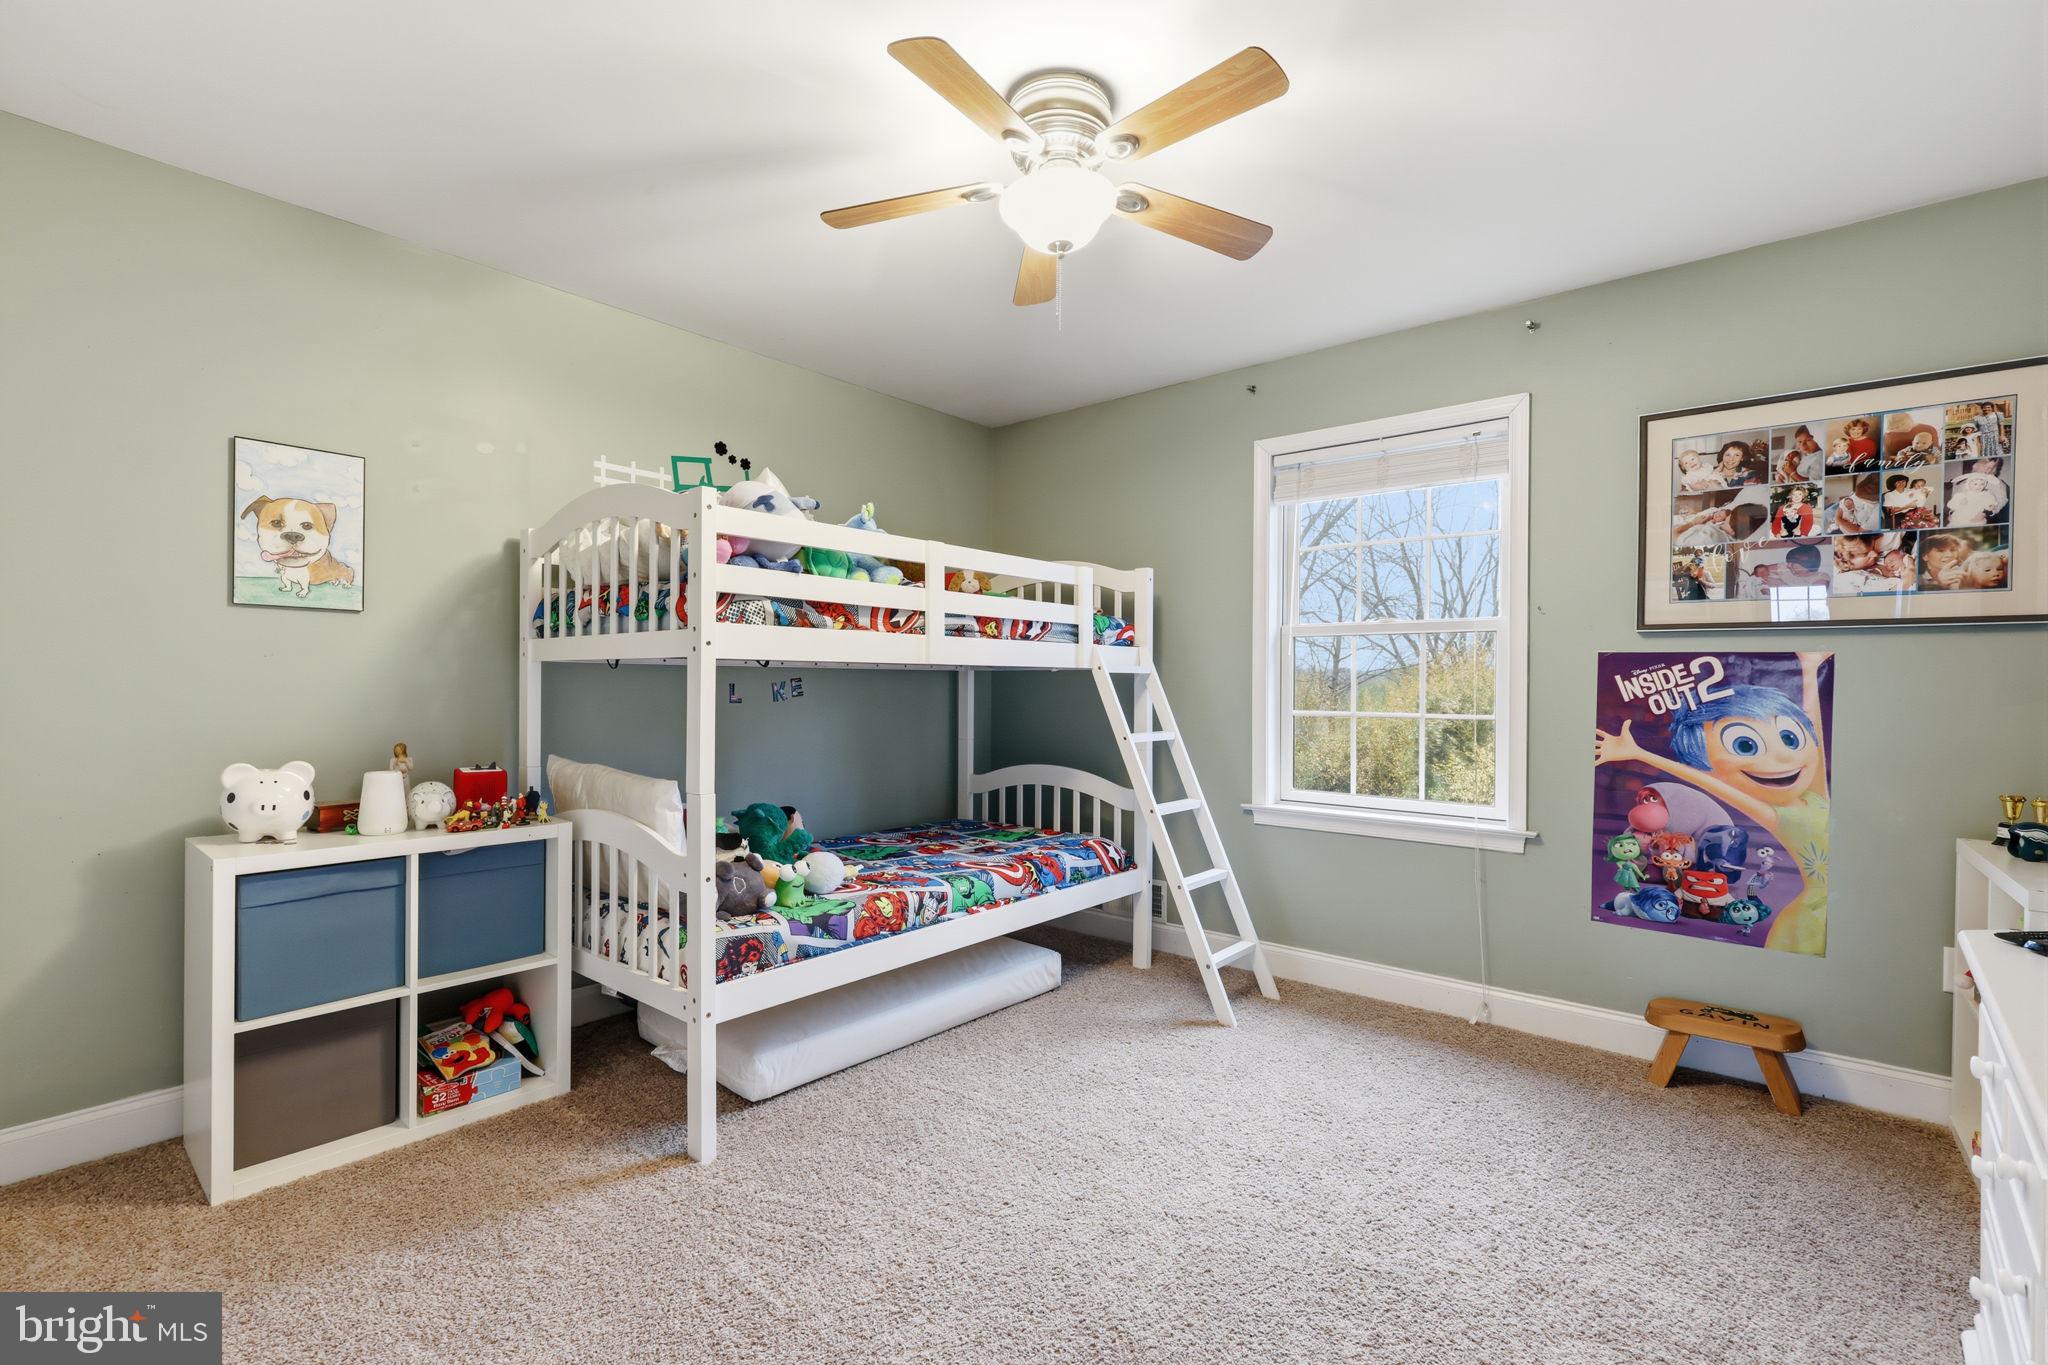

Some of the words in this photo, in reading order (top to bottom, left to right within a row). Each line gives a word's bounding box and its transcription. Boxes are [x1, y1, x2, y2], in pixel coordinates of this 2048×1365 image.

[1843, 452, 1927, 474] family
[1712, 536, 1769, 573] love
[1614, 663, 1695, 703] INSIDE
[1689, 656, 1736, 704] 2
[1648, 682, 1698, 715] OUT
[1679, 1008, 1770, 1029] GAVIN
[432, 1092, 447, 1105] 32
